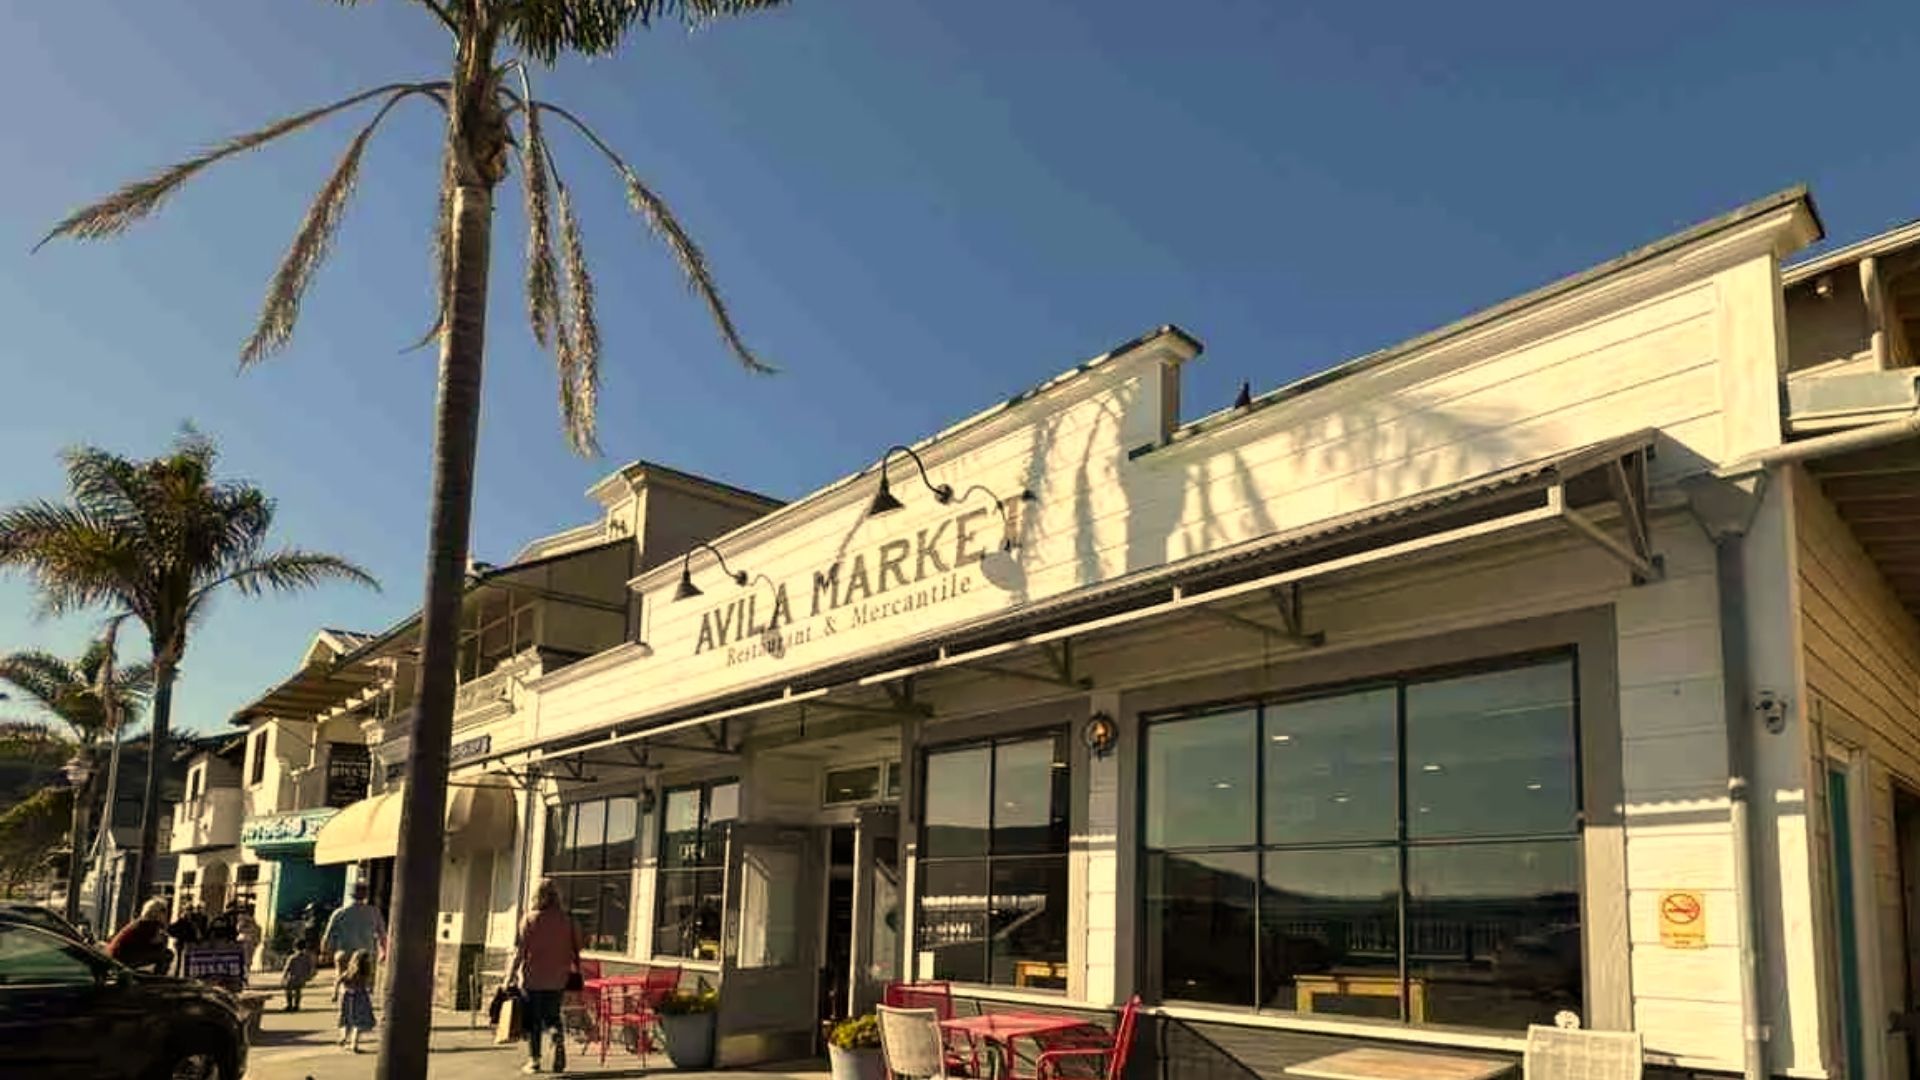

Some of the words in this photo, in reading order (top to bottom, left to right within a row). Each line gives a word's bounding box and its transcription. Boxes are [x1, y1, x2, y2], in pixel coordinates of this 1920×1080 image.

[695, 582, 793, 655] AVILA
[810, 496, 1026, 617] MARKET
[824, 616, 838, 637] &
[851, 574, 971, 629] Mercantile
